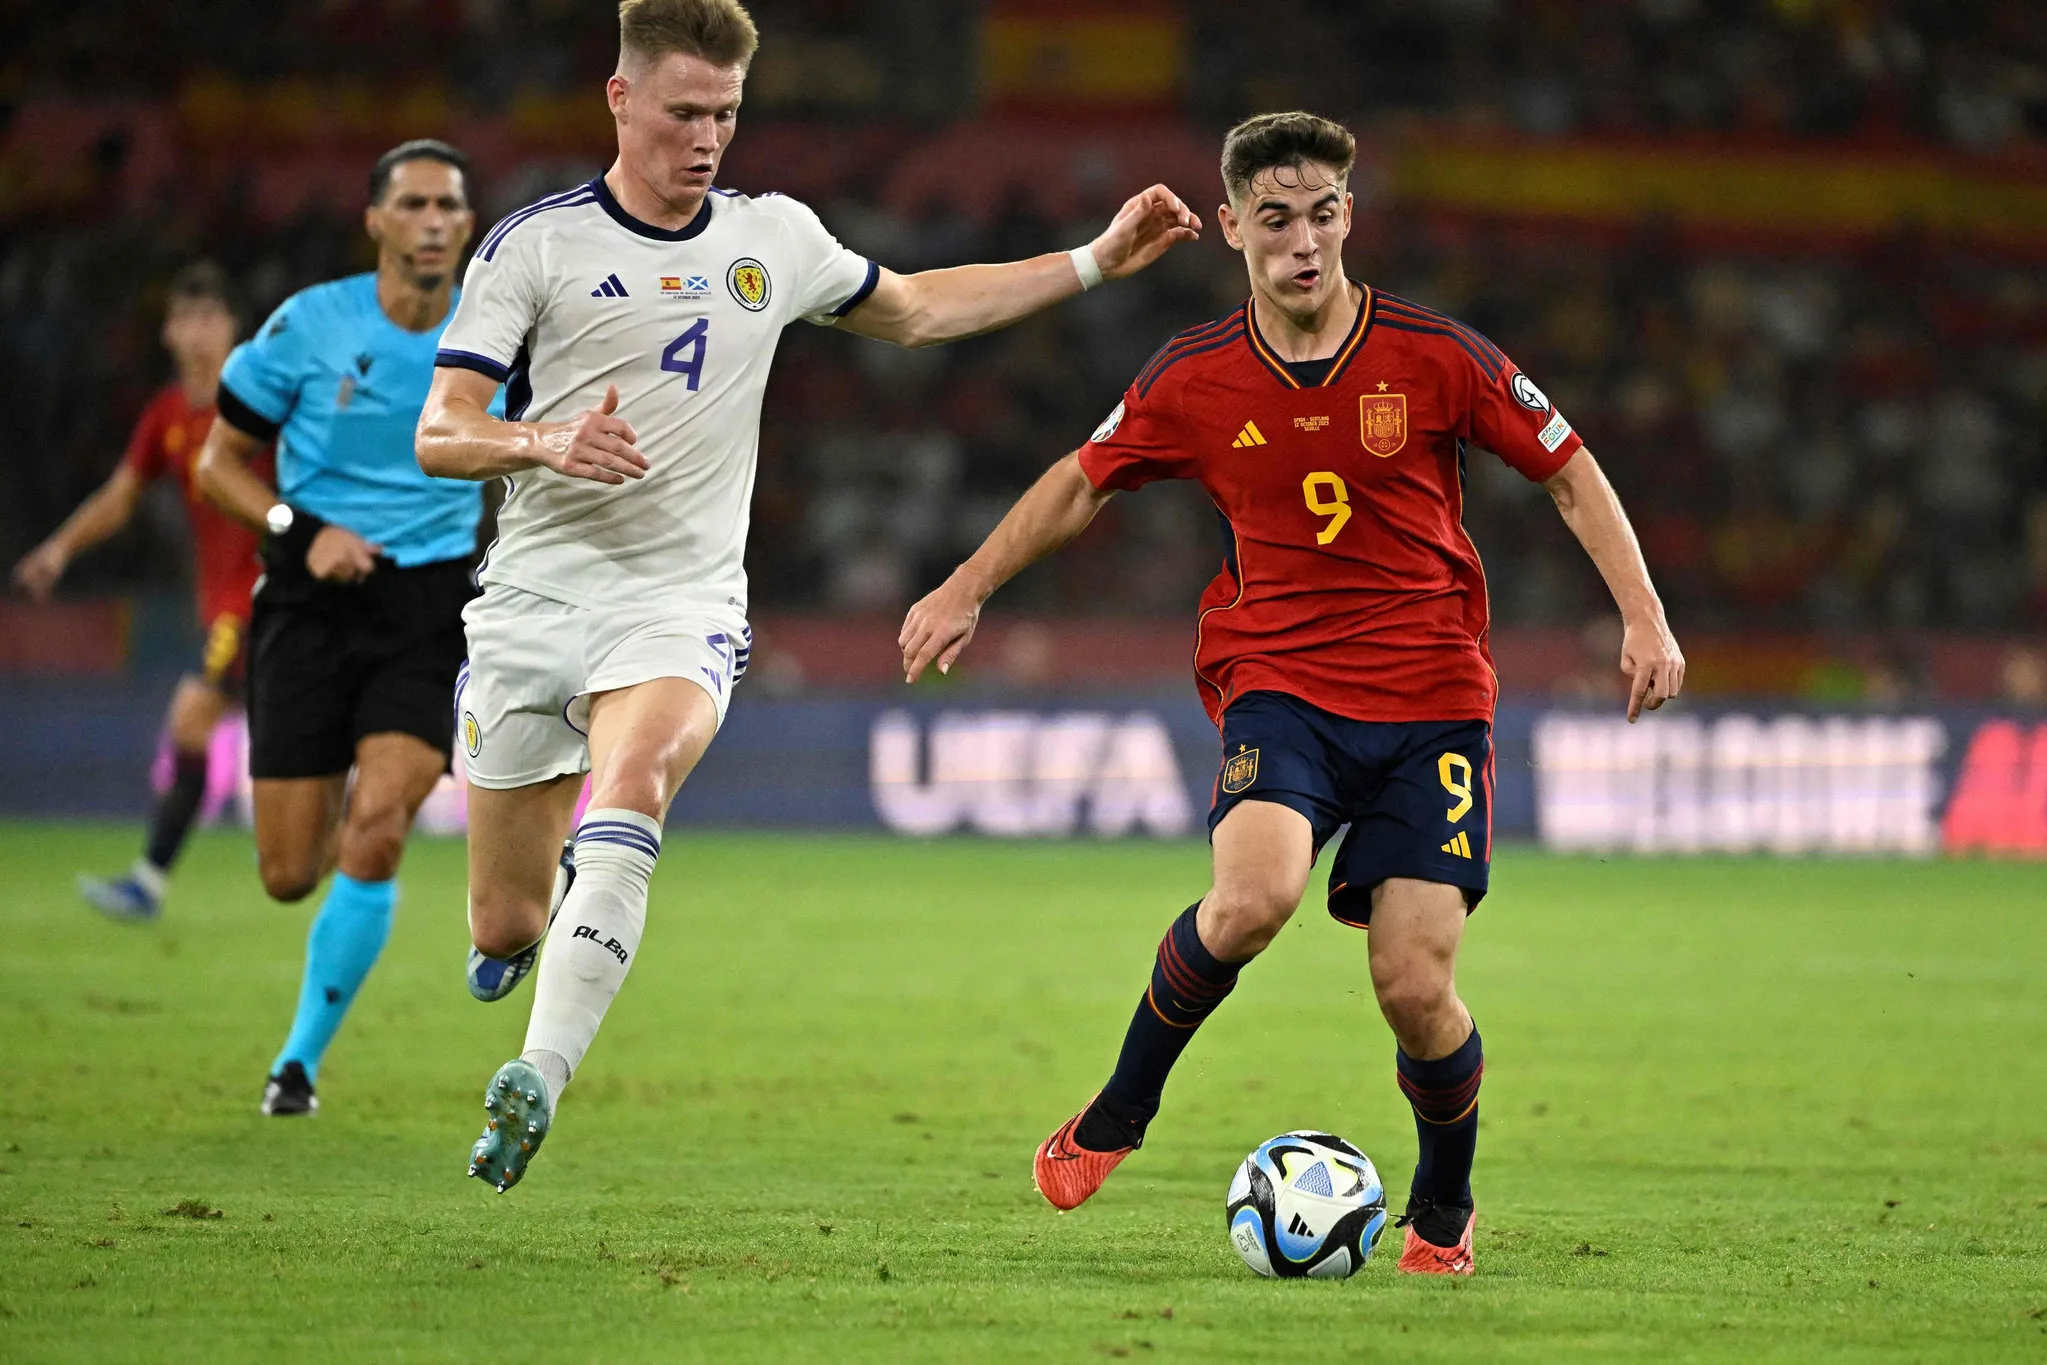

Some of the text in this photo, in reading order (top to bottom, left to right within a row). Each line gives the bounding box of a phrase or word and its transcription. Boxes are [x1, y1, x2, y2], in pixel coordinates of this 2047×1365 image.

[660, 317, 709, 391] 4
[1302, 471, 1352, 545] 9
[870, 711, 1191, 835] UEFA
[1437, 752, 1473, 824] 9
[571, 925, 628, 965] ALBA
